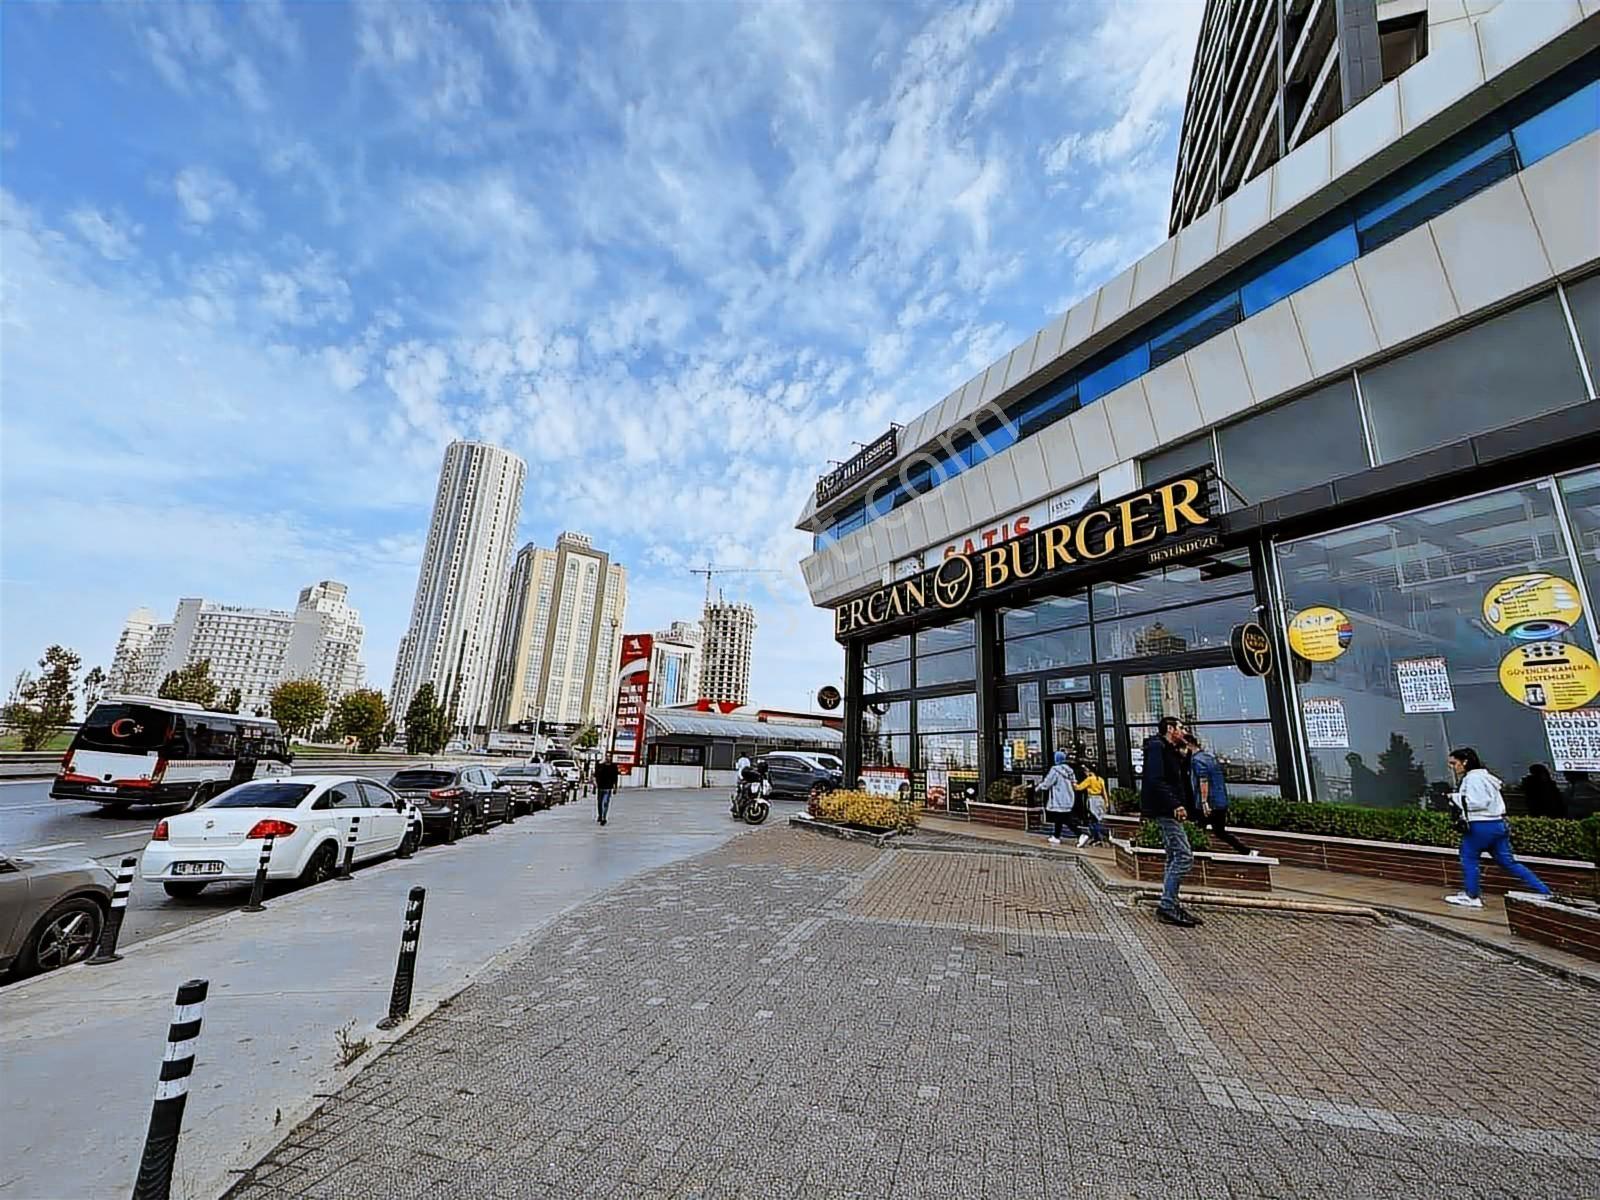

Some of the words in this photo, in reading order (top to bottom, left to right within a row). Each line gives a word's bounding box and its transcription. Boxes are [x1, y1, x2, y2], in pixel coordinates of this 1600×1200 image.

[836, 578, 925, 634] ERCAN
[984, 479, 1210, 589] BURGER
[1399, 668, 1446, 677] MONDE
[1506, 666, 1549, 677] GÜVENLİK
[1551, 664, 1591, 673] KAMERA
[1525, 672, 1575, 682] SİSTEMLERİ
[1547, 720, 1600, 729] MOND
